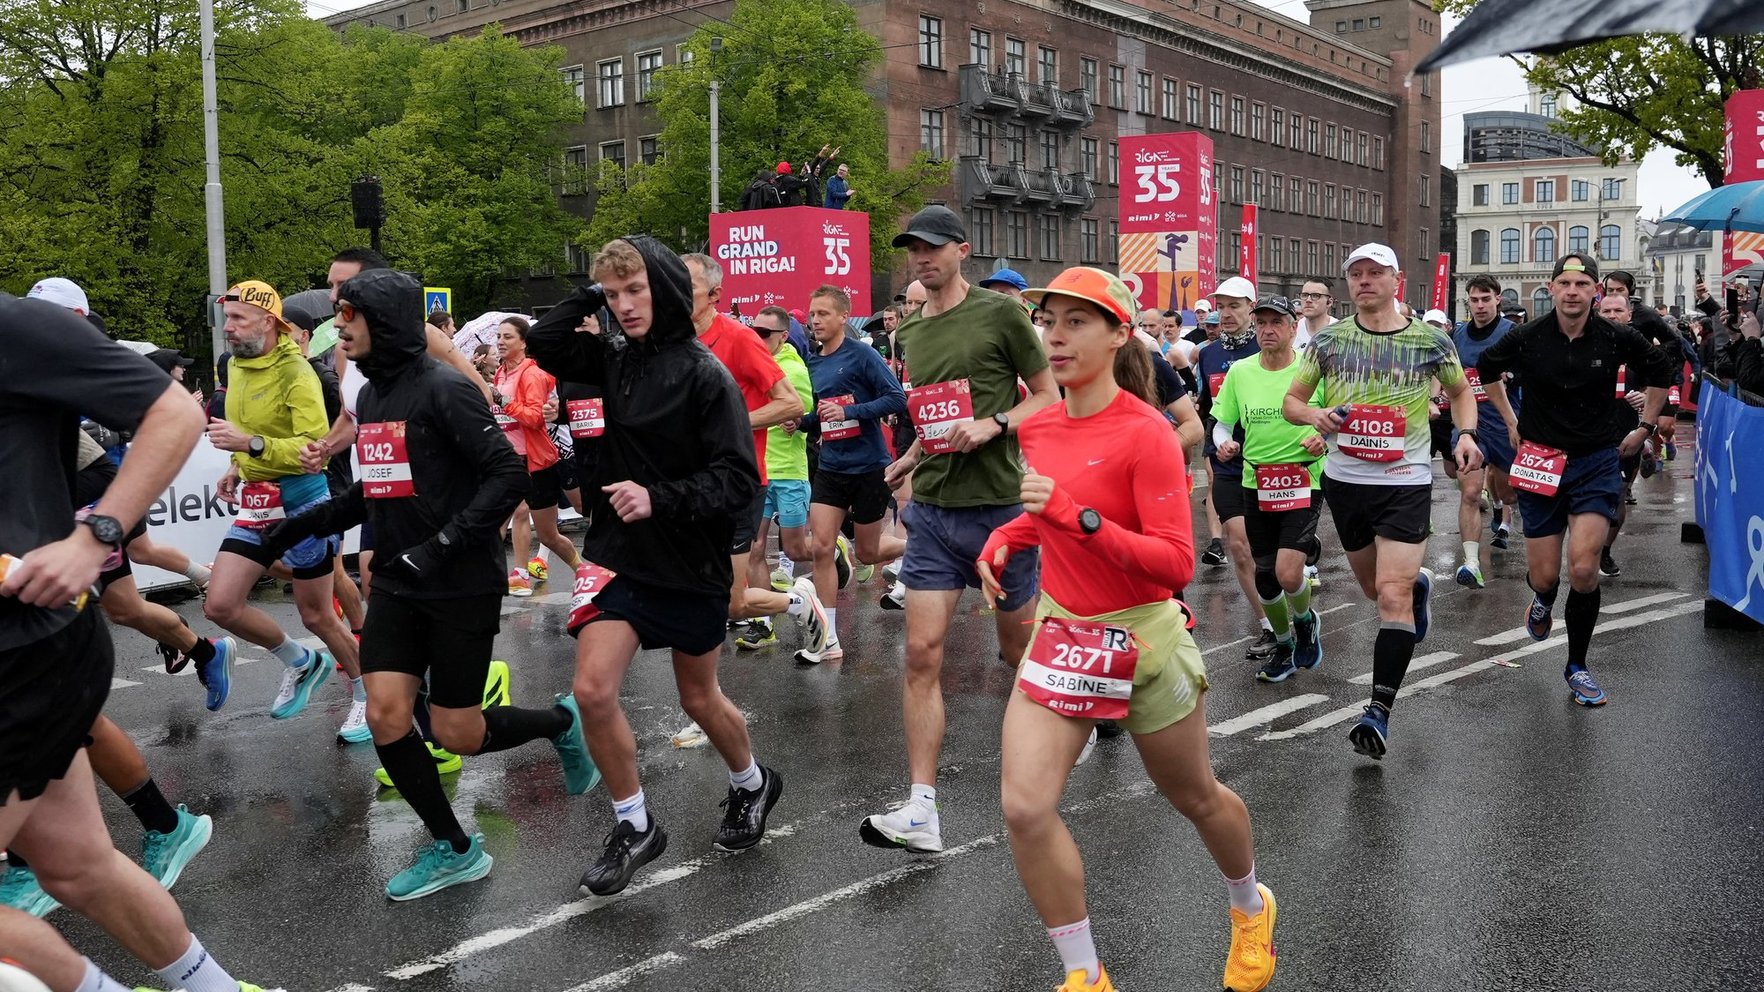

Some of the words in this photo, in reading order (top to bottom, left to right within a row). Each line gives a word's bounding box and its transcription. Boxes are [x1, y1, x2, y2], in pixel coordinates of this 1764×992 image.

[1135, 164, 1180, 203] 35
[729, 225, 764, 242] RUN
[718, 241, 778, 259] GRAND
[823, 238, 850, 275] 35
[730, 258, 746, 275] IN
[750, 256, 795, 274] RIGA!
[572, 408, 598, 420] 2375
[918, 400, 960, 421] 4236
[1349, 419, 1394, 434] 4108
[363, 442, 394, 461] 1242
[1520, 453, 1554, 471] 2674
[368, 468, 392, 478] JOSEF
[1262, 475, 1302, 489] 2403
[1514, 468, 1553, 482] DONATAS
[244, 494, 270, 507] 067
[1269, 491, 1295, 500] HANS
[1051, 643, 1113, 673] 2671
[1046, 674, 1107, 694] SABĪNE
